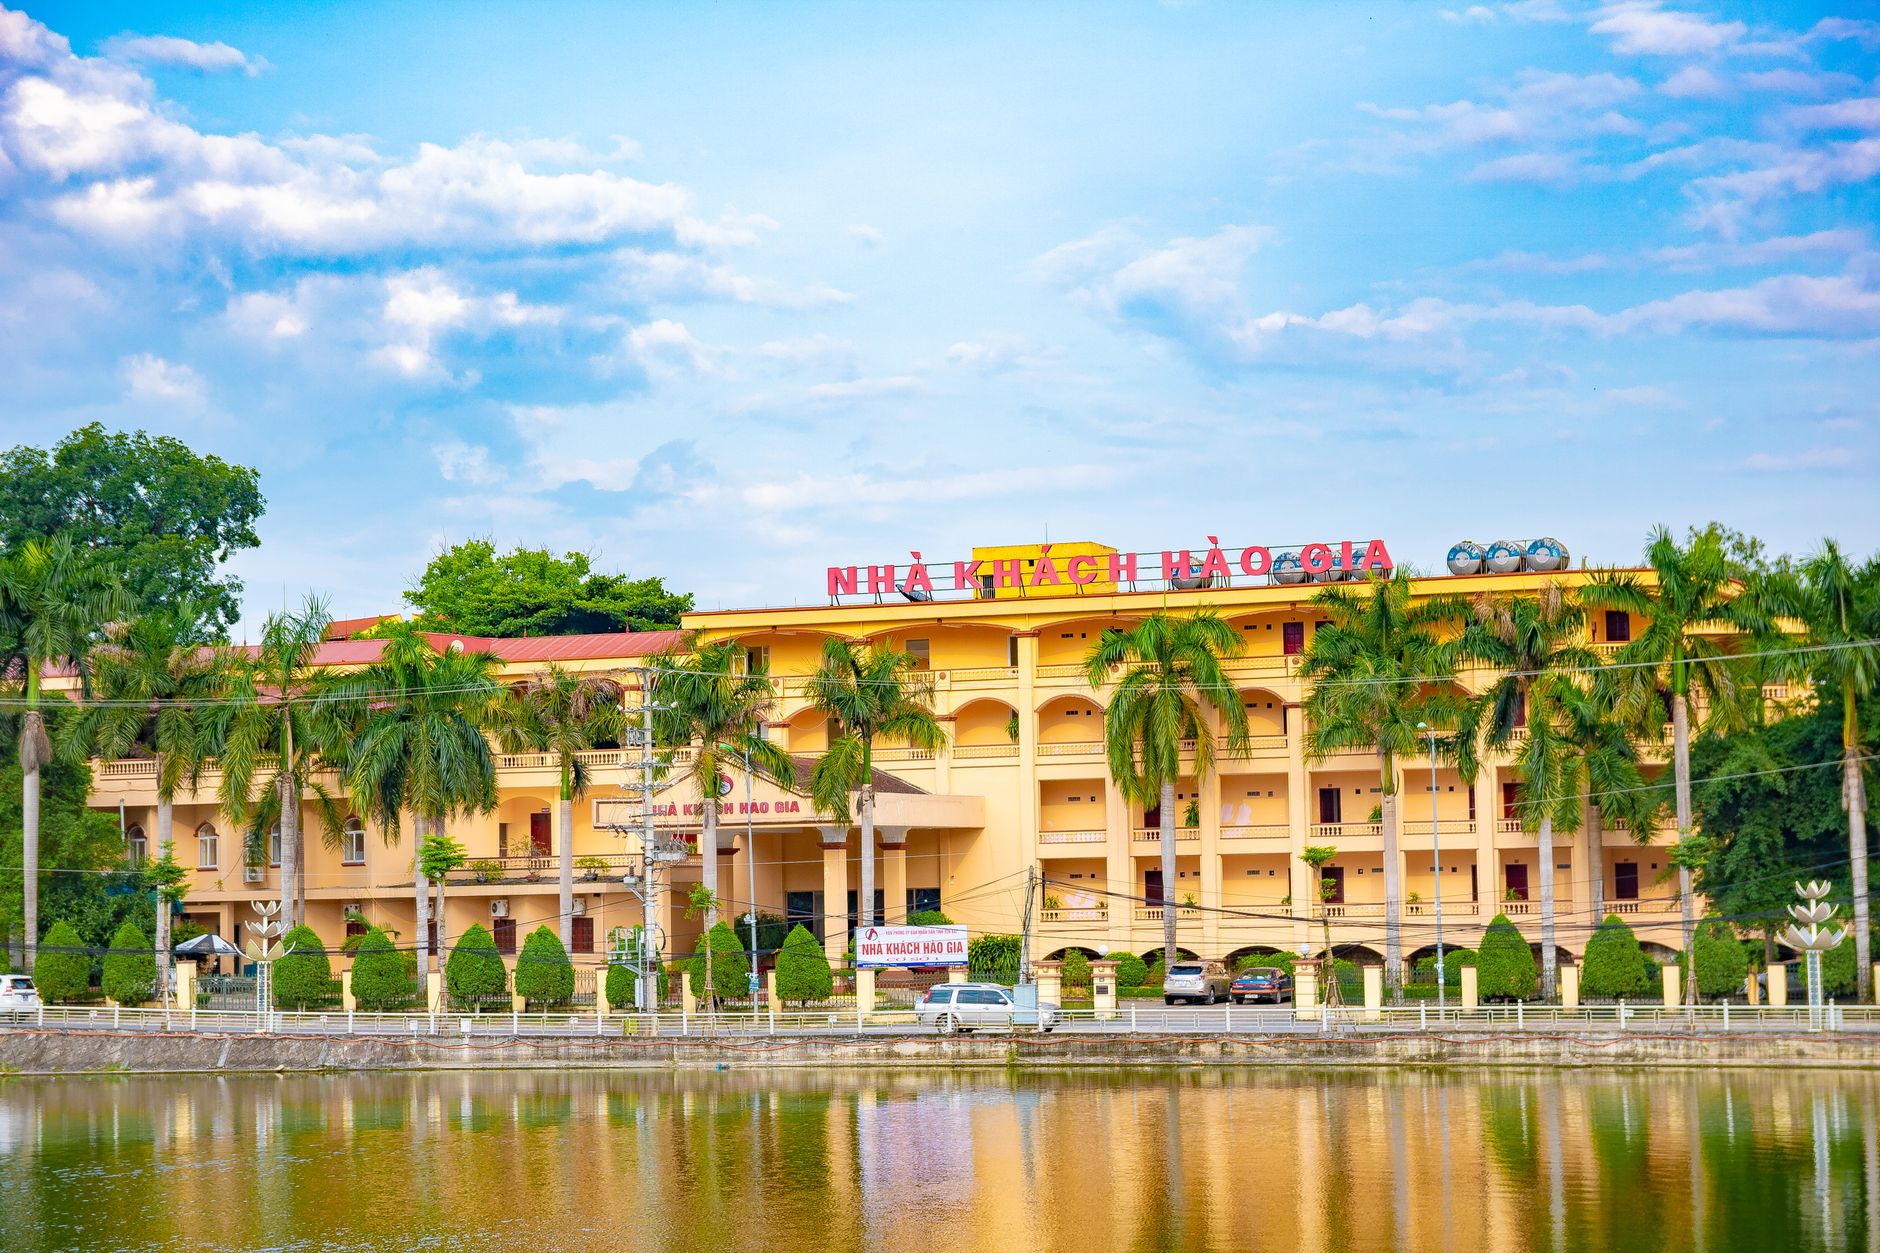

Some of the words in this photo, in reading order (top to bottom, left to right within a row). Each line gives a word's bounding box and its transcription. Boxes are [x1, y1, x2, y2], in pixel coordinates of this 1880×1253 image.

[828, 551, 933, 595] NHÀ
[954, 544, 1137, 590] KHÁCH
[1161, 535, 1272, 580] HÀO
[1300, 539, 1394, 574] GIA
[775, 801, 800, 813] GIA
[861, 940, 882, 955] NHÀ
[886, 940, 920, 955] KHÁCH
[923, 939, 943, 954] HÀO
[946, 941, 963, 953] GIA
